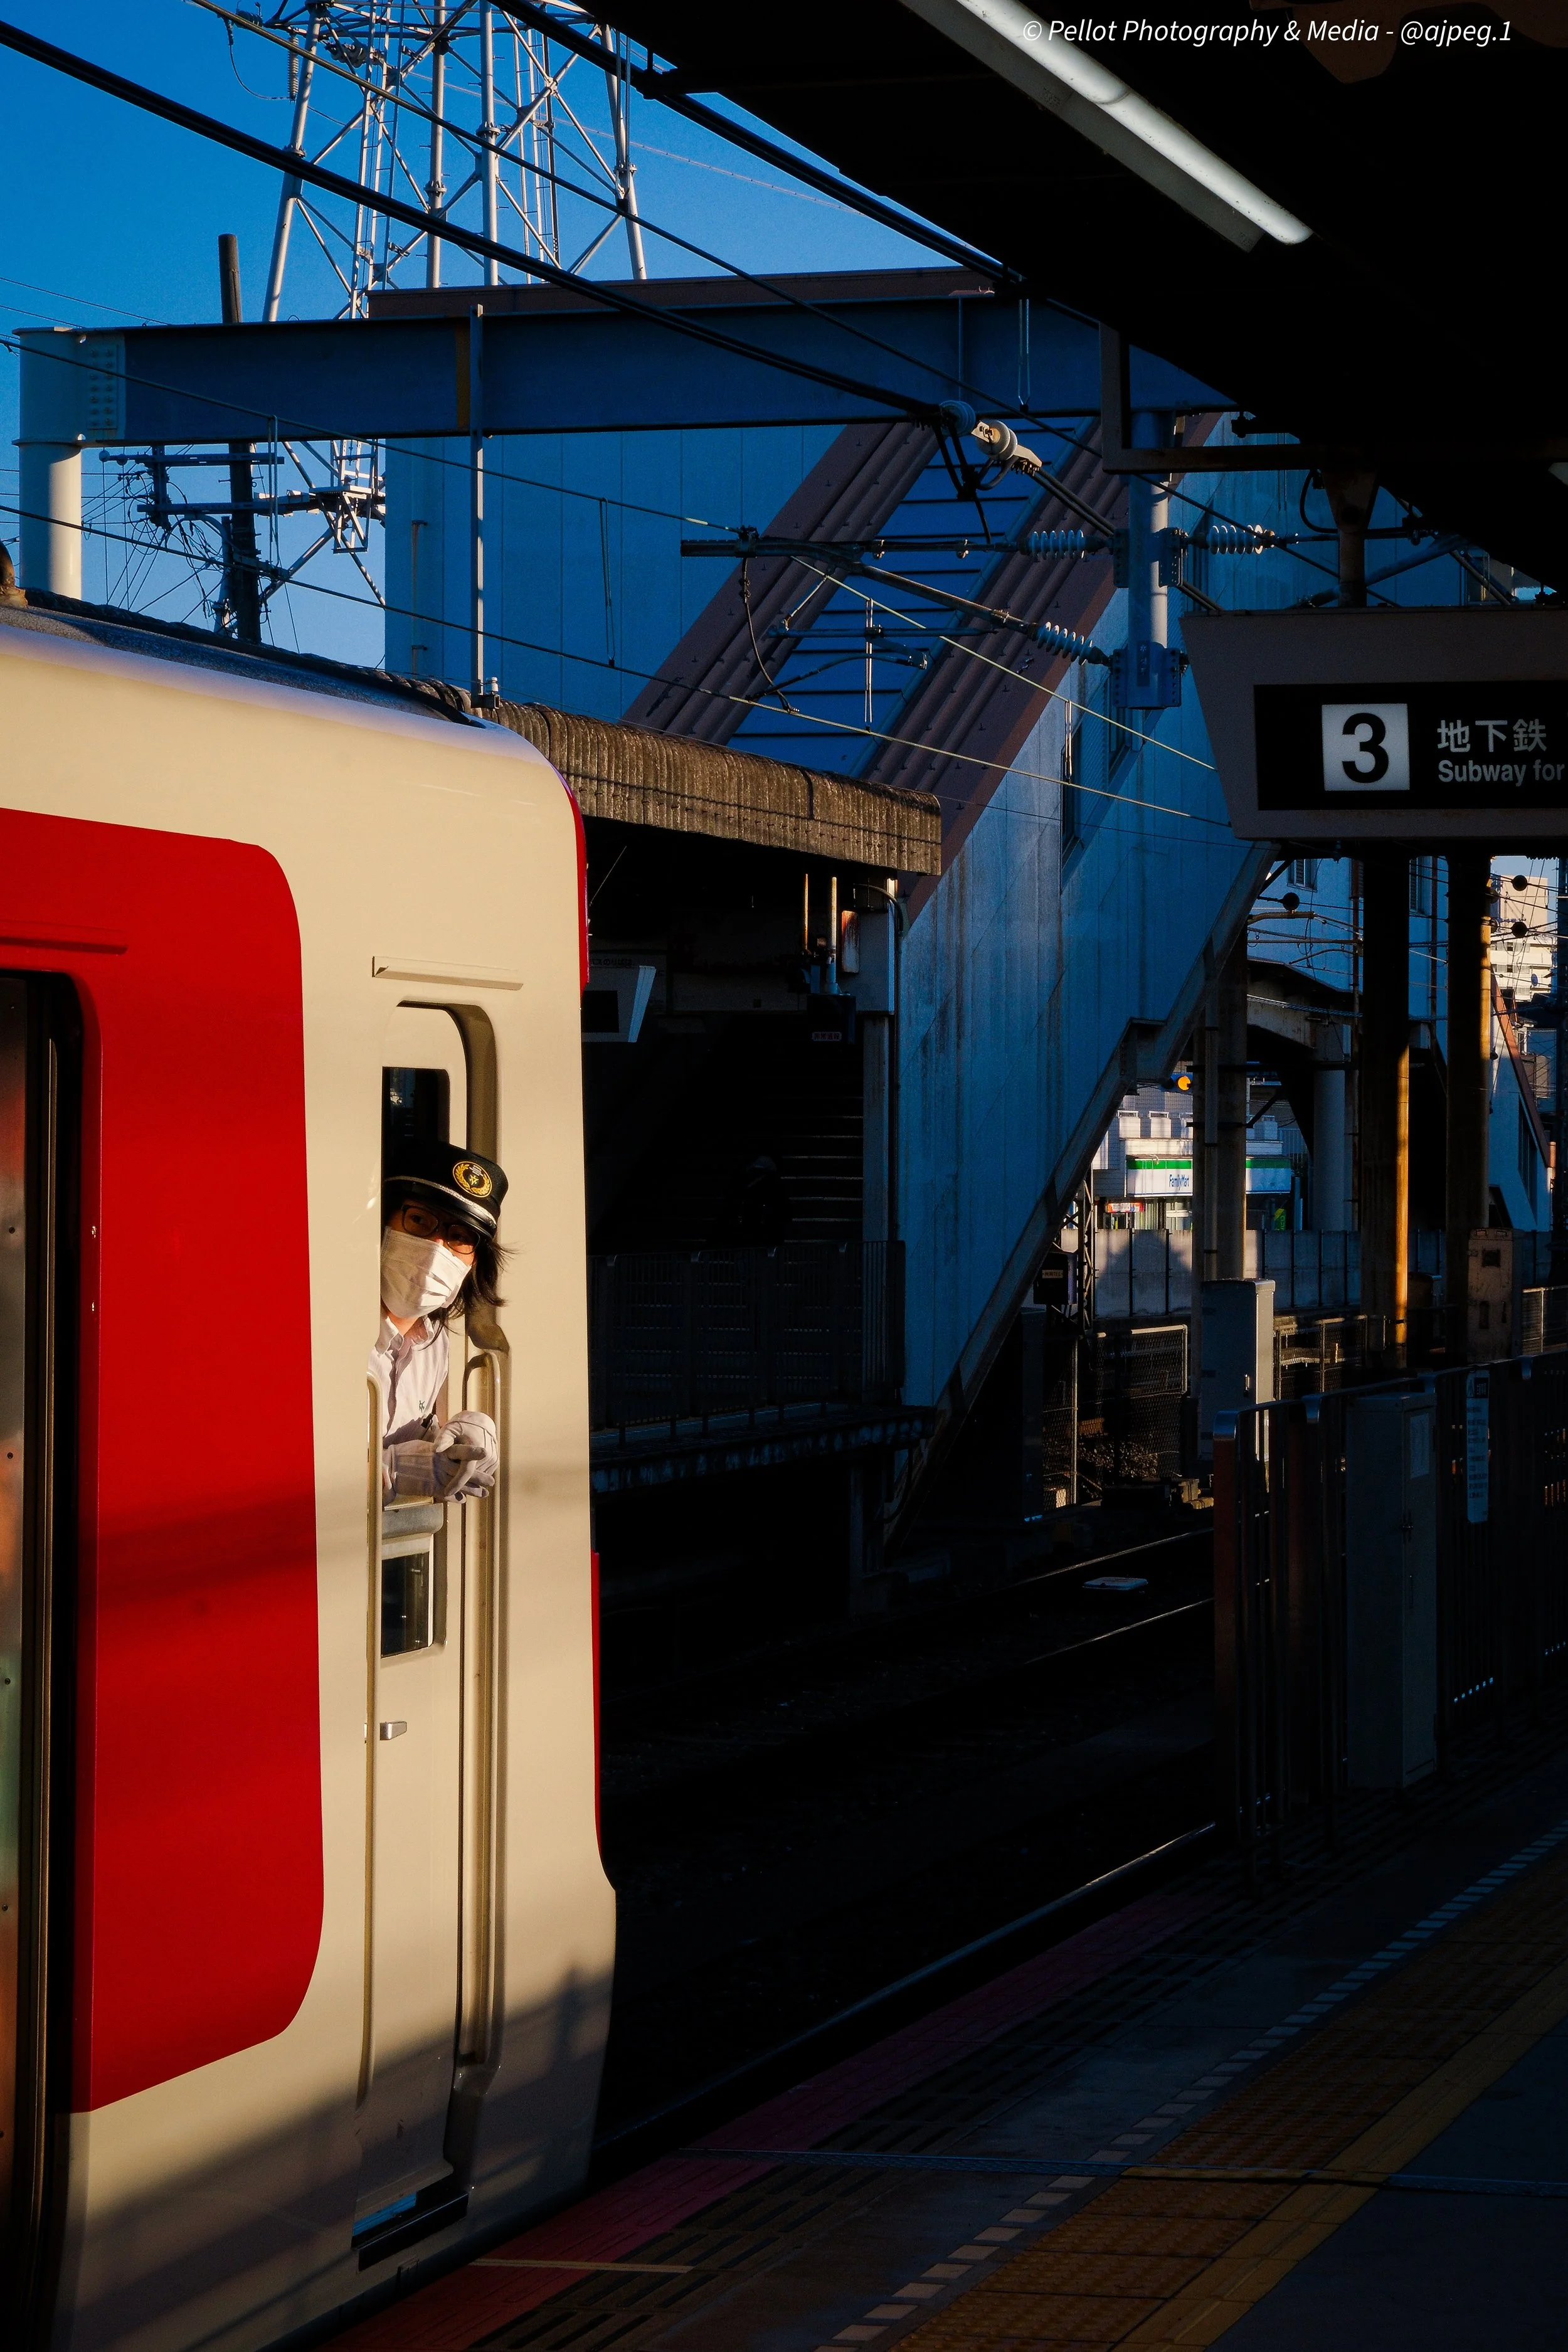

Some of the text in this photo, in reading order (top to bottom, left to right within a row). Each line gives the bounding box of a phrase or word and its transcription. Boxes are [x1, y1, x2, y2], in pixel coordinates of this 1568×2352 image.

[1342, 712, 1390, 784] 3
[1437, 718, 1547, 753] 地下鉄
[1438, 759, 1565, 787] Subway for
[1168, 1174, 1189, 1190] FamilyMart
